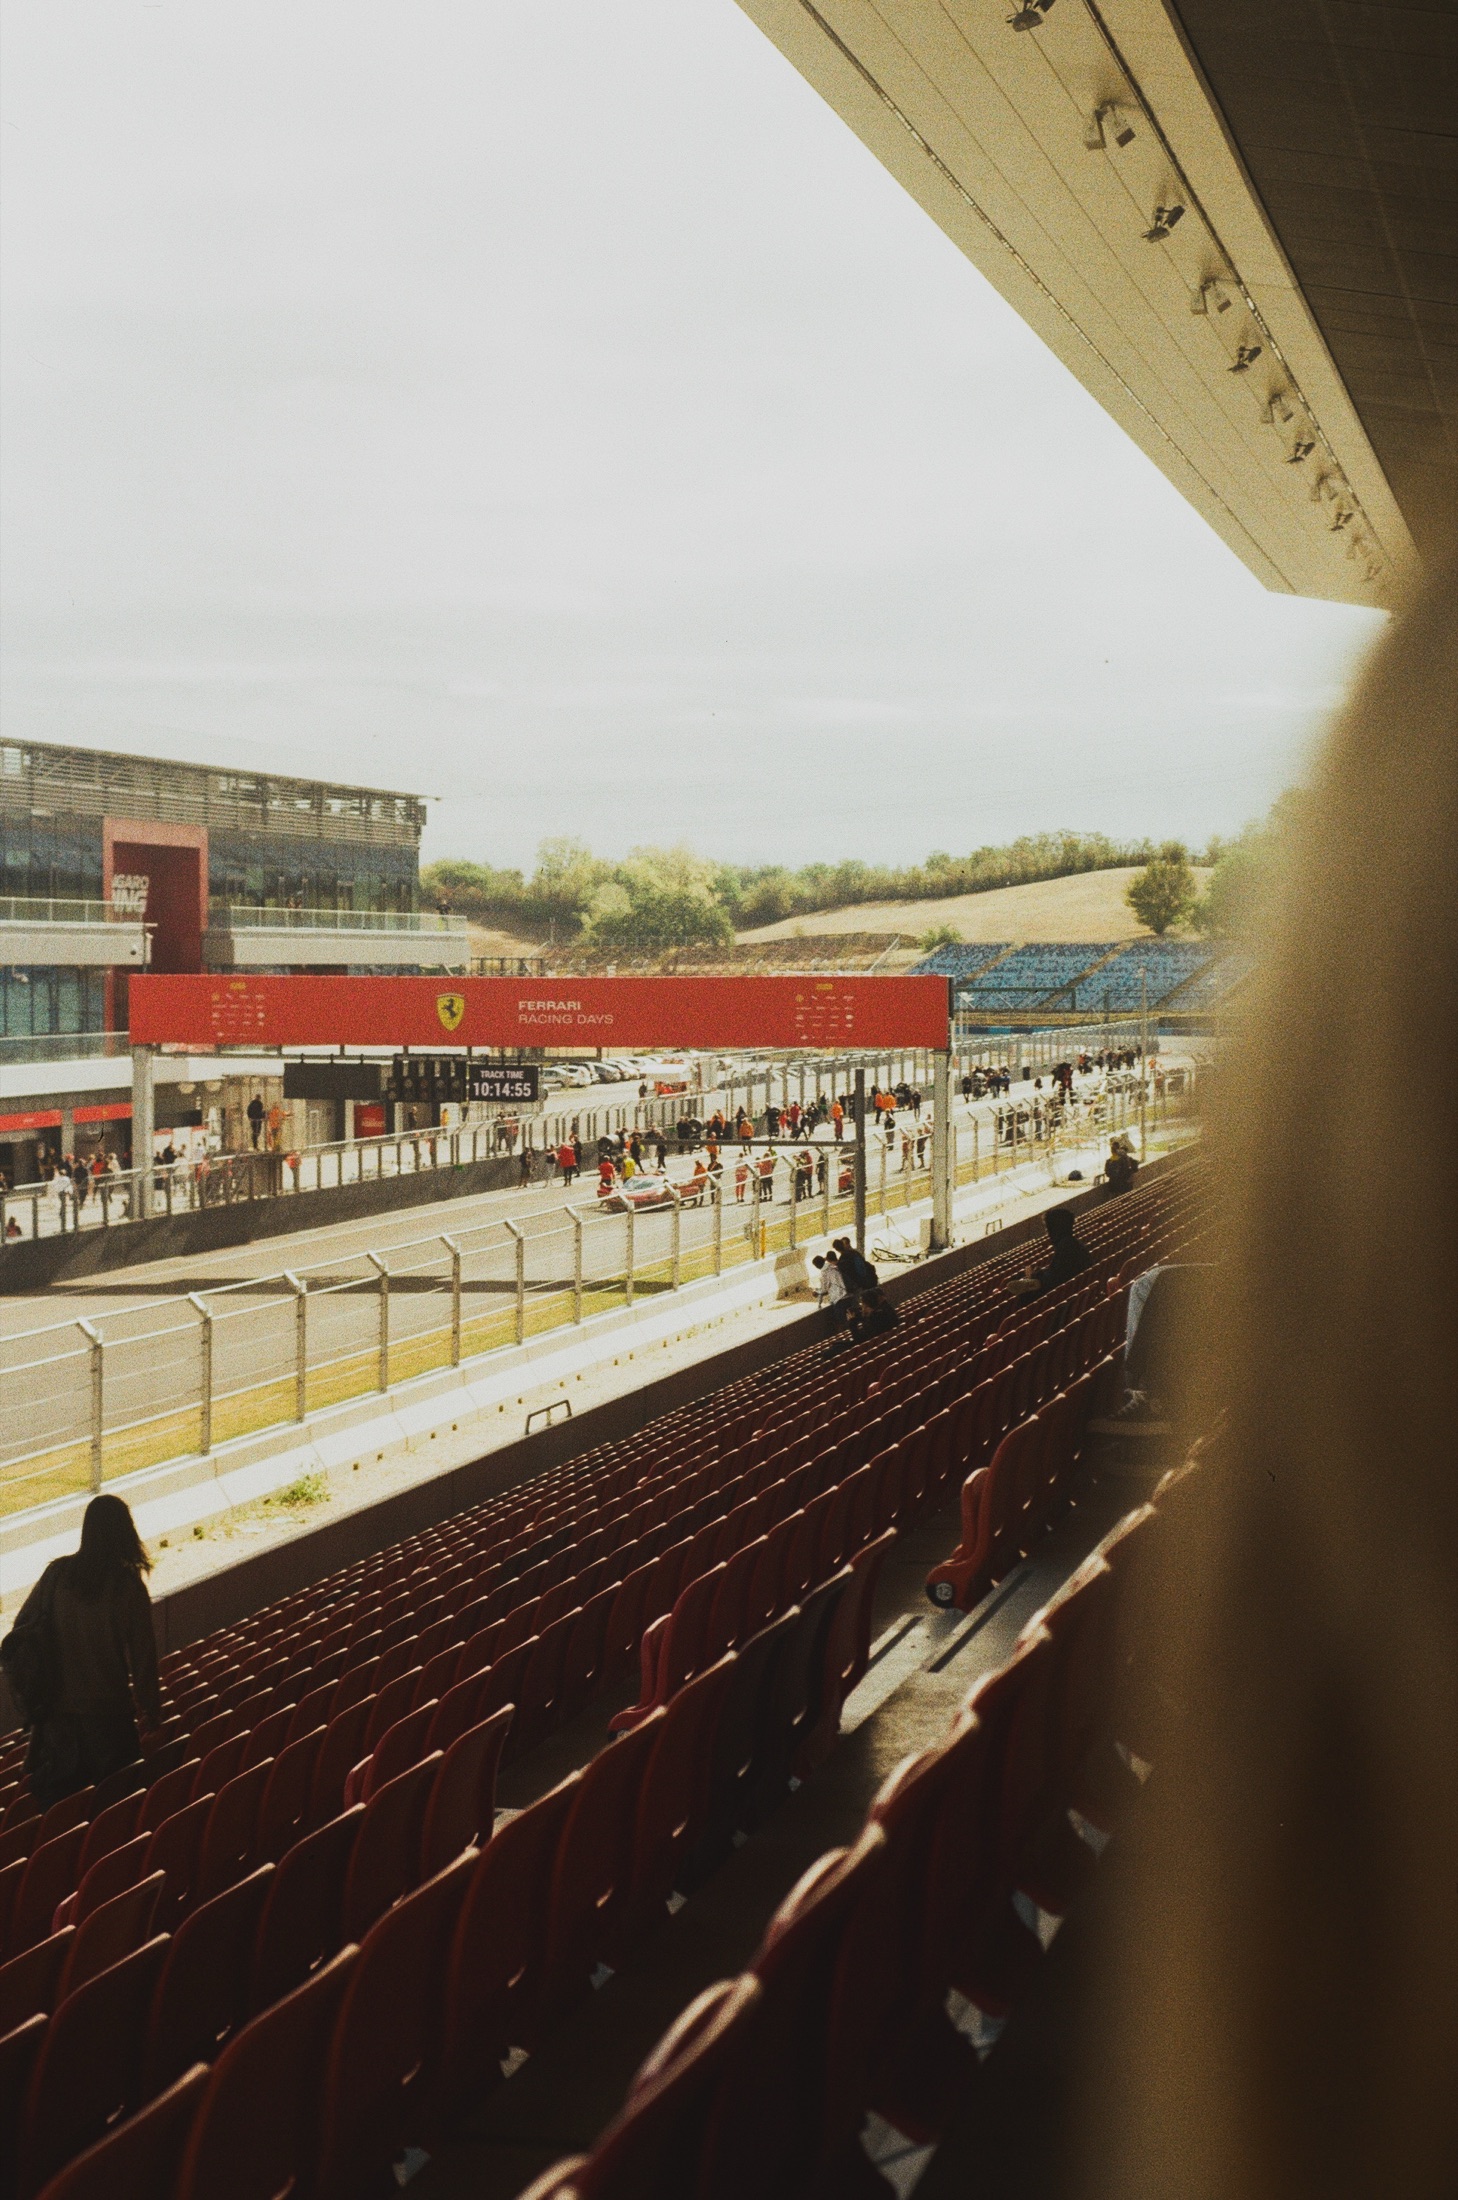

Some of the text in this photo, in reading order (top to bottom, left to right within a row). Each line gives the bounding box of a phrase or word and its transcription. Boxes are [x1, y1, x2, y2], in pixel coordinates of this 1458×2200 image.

[518, 1000, 581, 1011] FERRARI
[518, 1013, 614, 1025] RACING DAYS
[480, 1070, 525, 1080] TRACK TIME
[473, 1082, 532, 1097] 10:14:55
